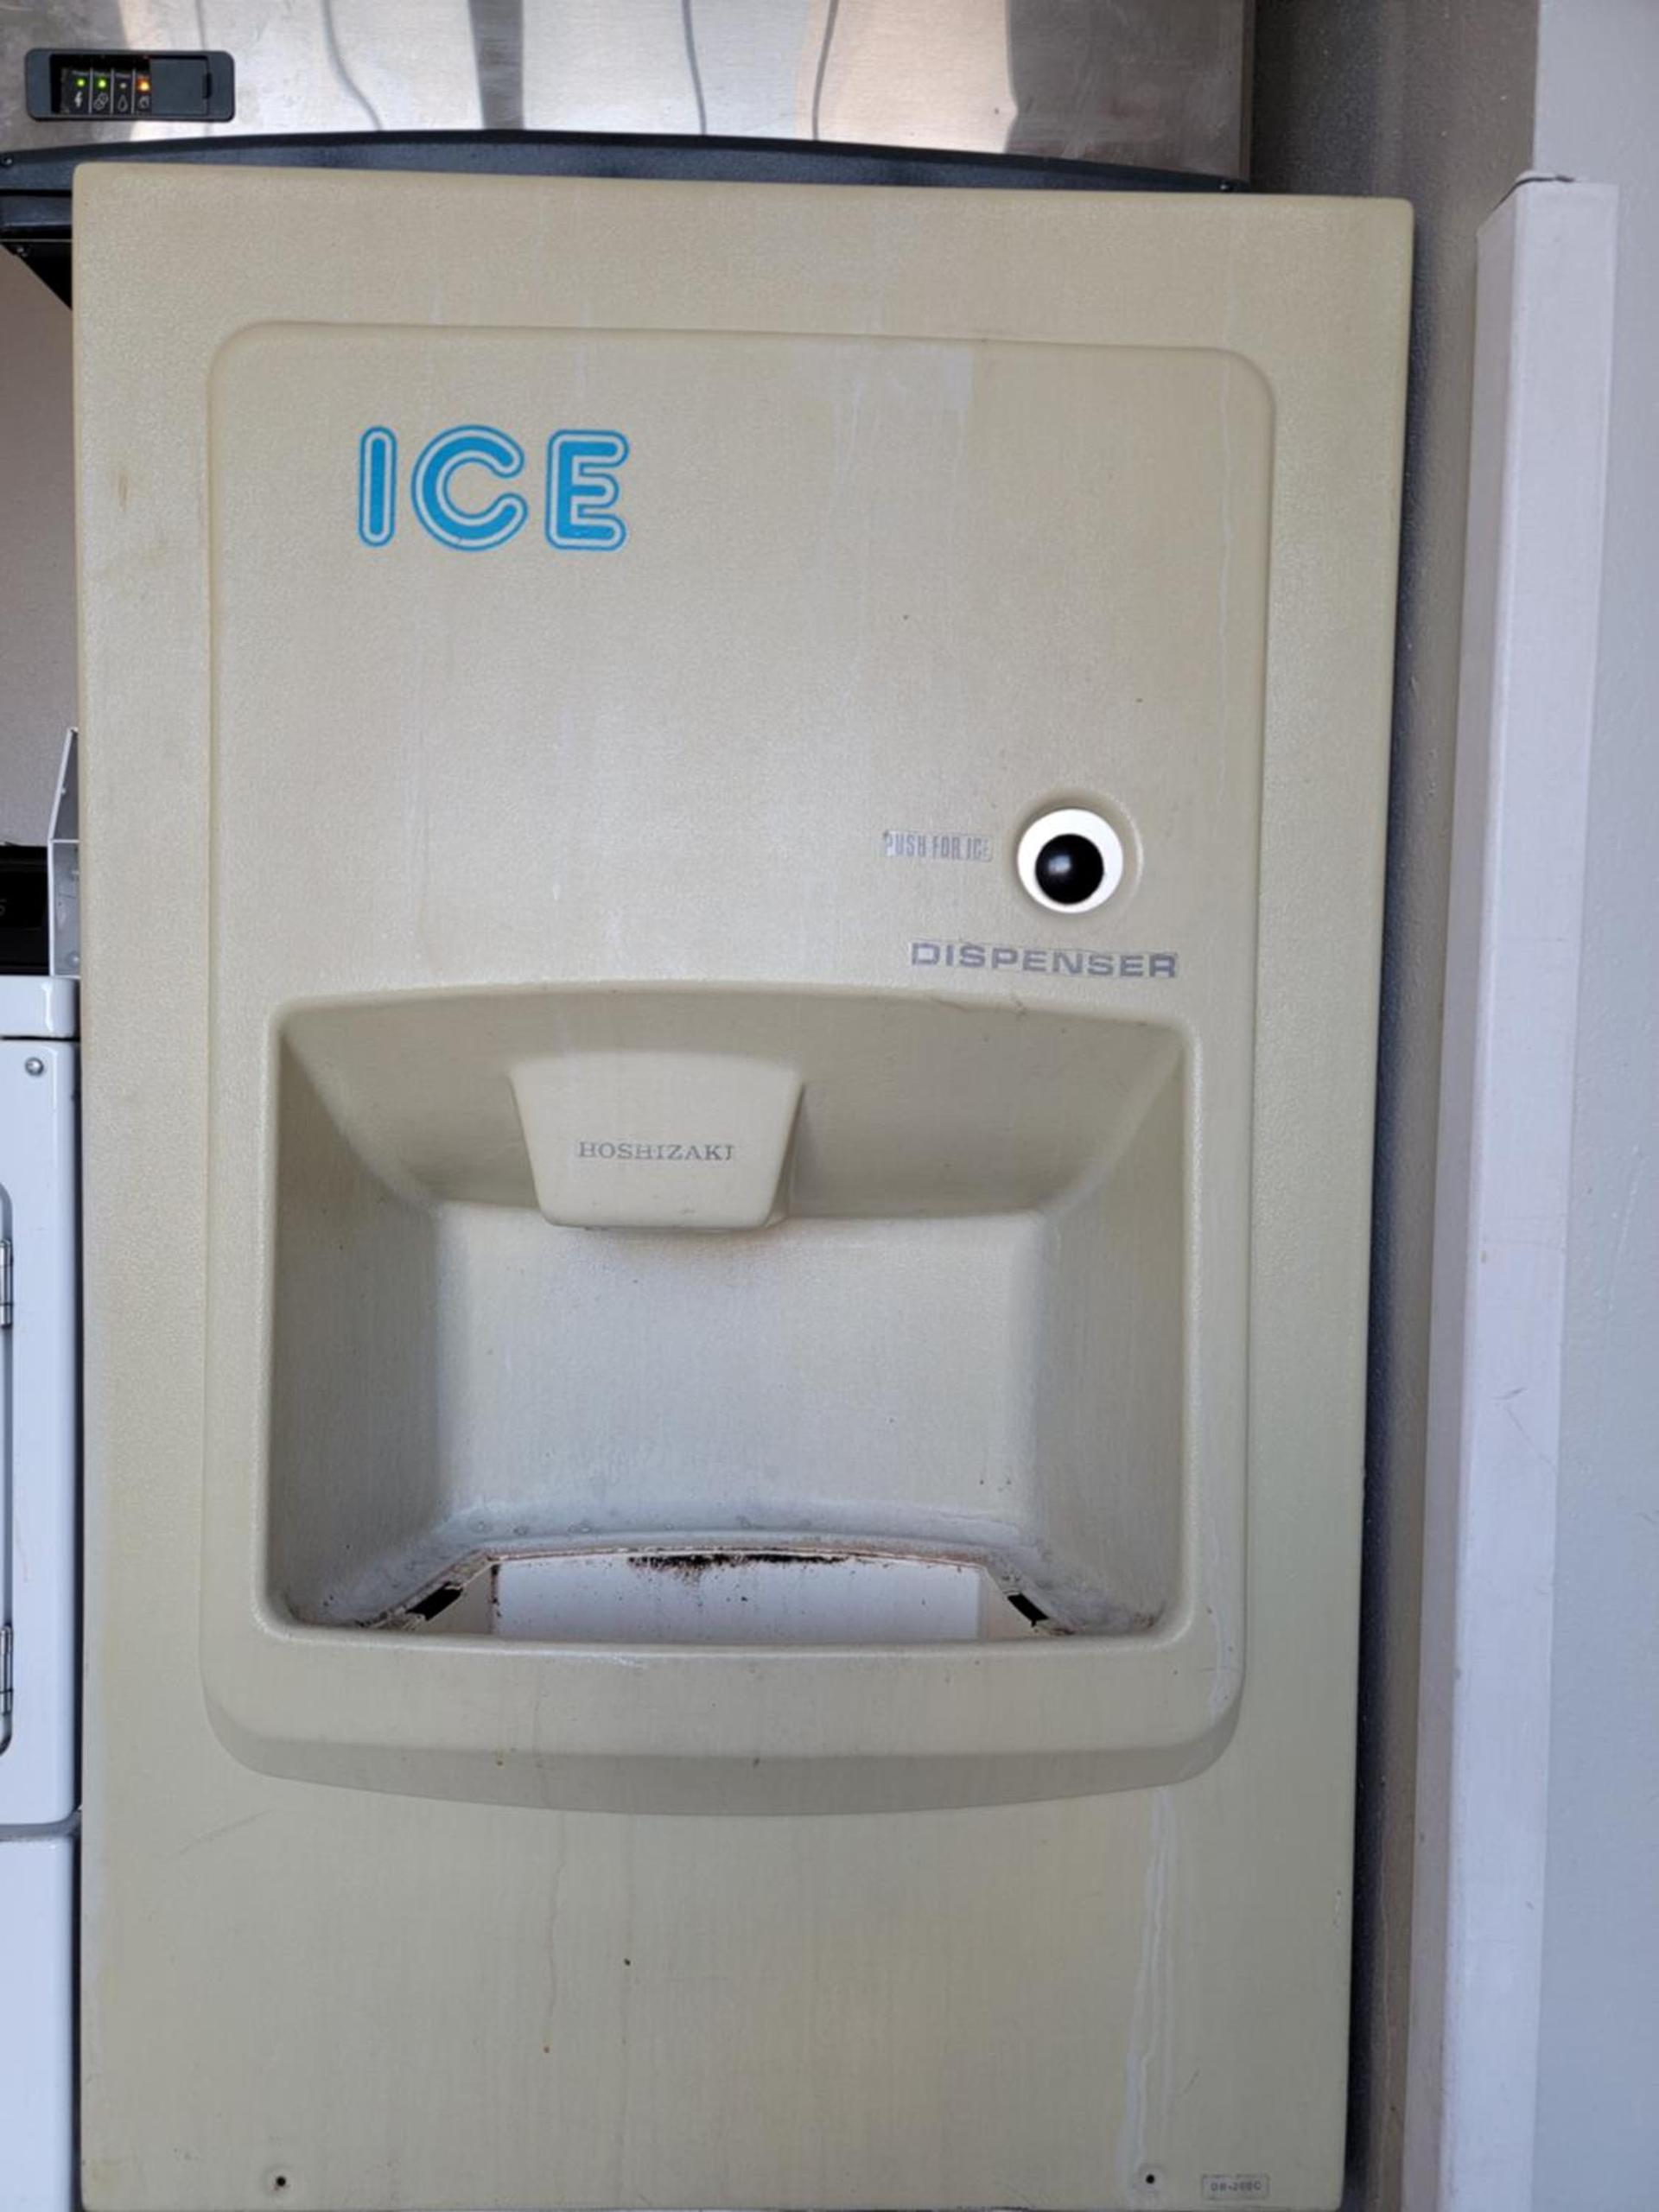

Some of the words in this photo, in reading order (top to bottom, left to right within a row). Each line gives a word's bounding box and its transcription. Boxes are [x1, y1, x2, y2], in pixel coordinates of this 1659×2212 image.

[359, 424, 629, 551] ICE
[884, 831, 926, 857] PUSH
[932, 835, 961, 860] FOR
[966, 836, 990, 861] ICE
[911, 942, 1178, 978] DISPENSER
[579, 1141, 734, 1161] HOSHIZAKI
